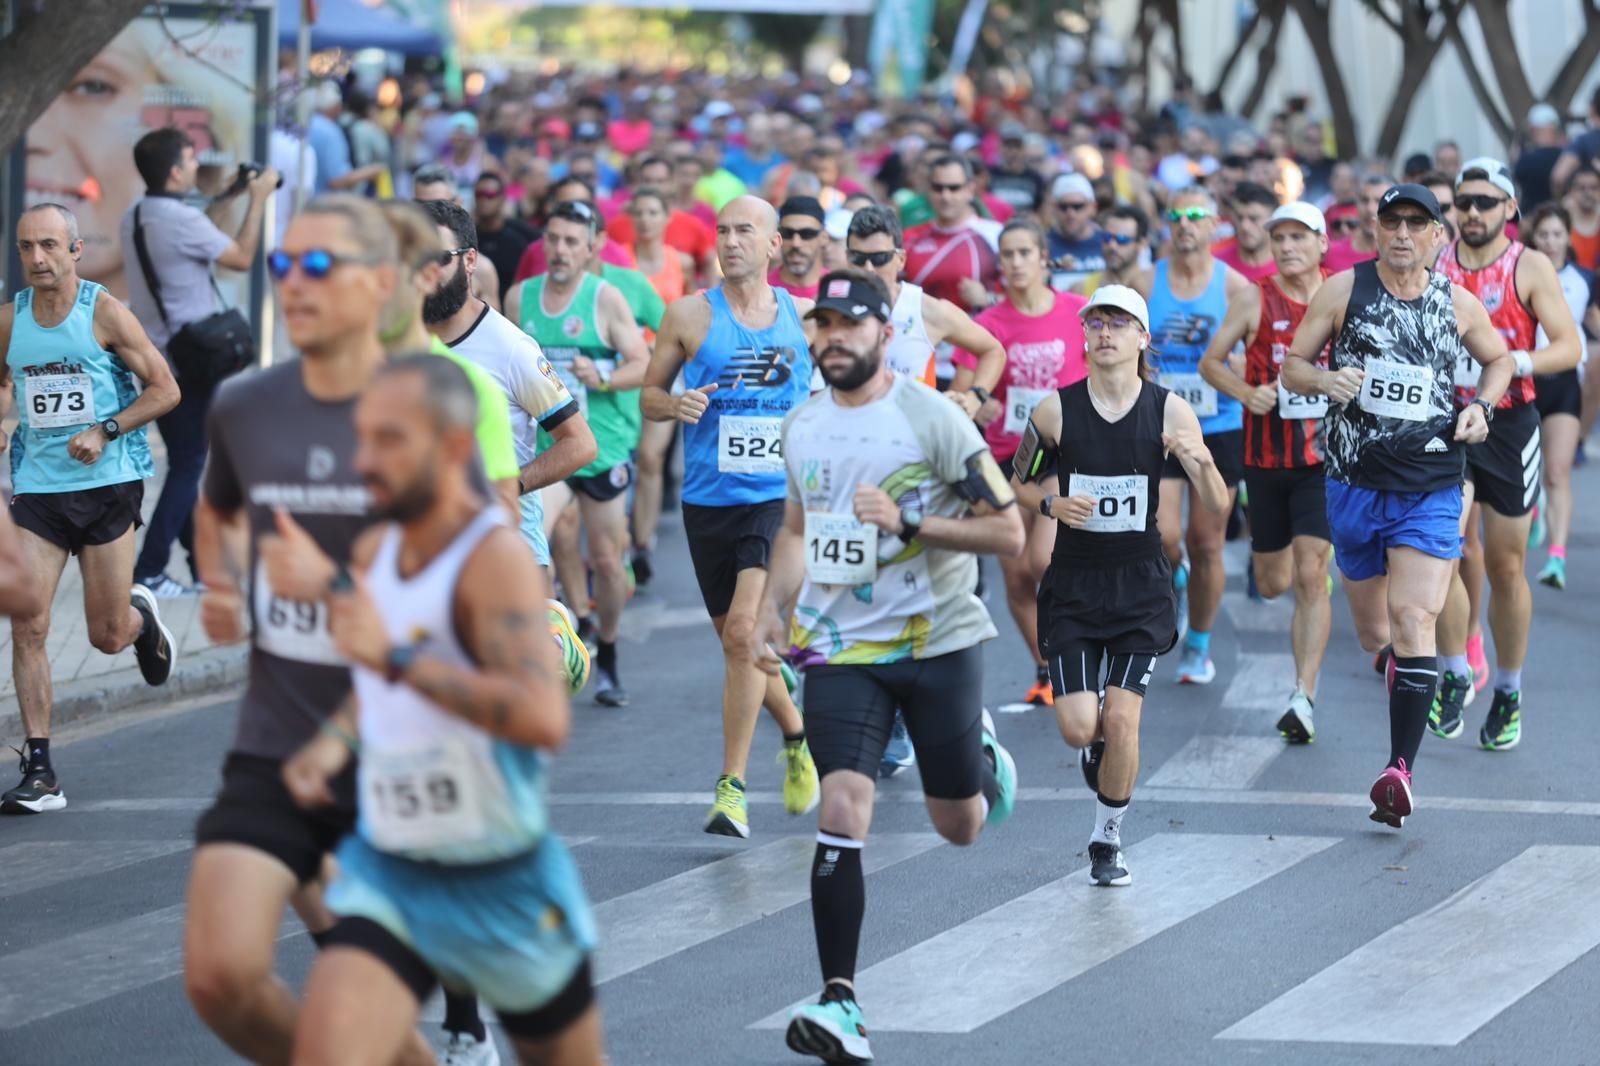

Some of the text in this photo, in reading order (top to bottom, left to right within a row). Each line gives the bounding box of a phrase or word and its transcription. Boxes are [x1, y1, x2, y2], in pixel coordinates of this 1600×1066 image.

[33, 391, 85, 414] 673
[1369, 378, 1423, 405] 596
[728, 436, 783, 458] 524
[1090, 495, 1137, 518] 01
[810, 538, 865, 565] 145
